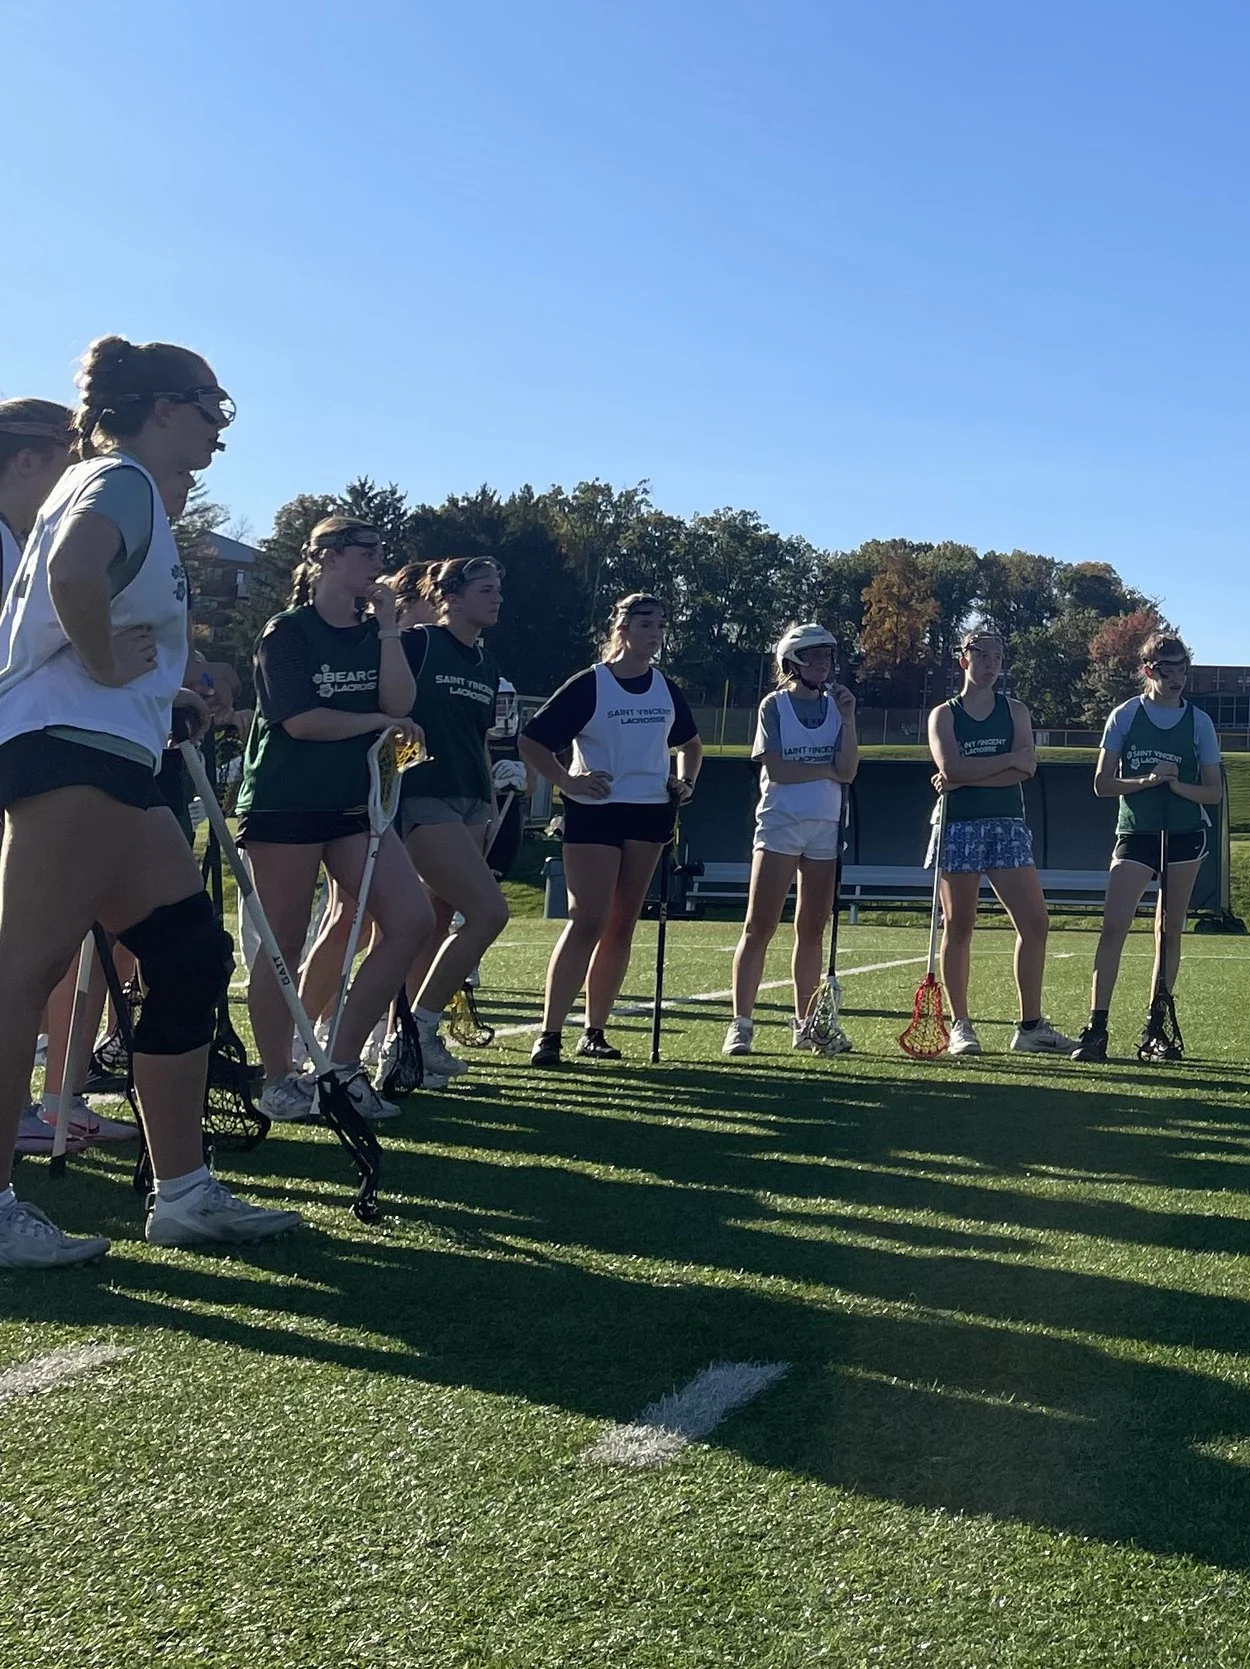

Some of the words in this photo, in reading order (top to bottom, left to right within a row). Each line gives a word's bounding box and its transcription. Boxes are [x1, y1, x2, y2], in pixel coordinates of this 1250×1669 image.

[435, 675, 465, 686] SAINT
[607, 709, 633, 719] SAINT
[621, 716, 666, 725] LACROSSE
[1132, 750, 1153, 758] SAINT
[272, 956, 291, 985] GAIT
